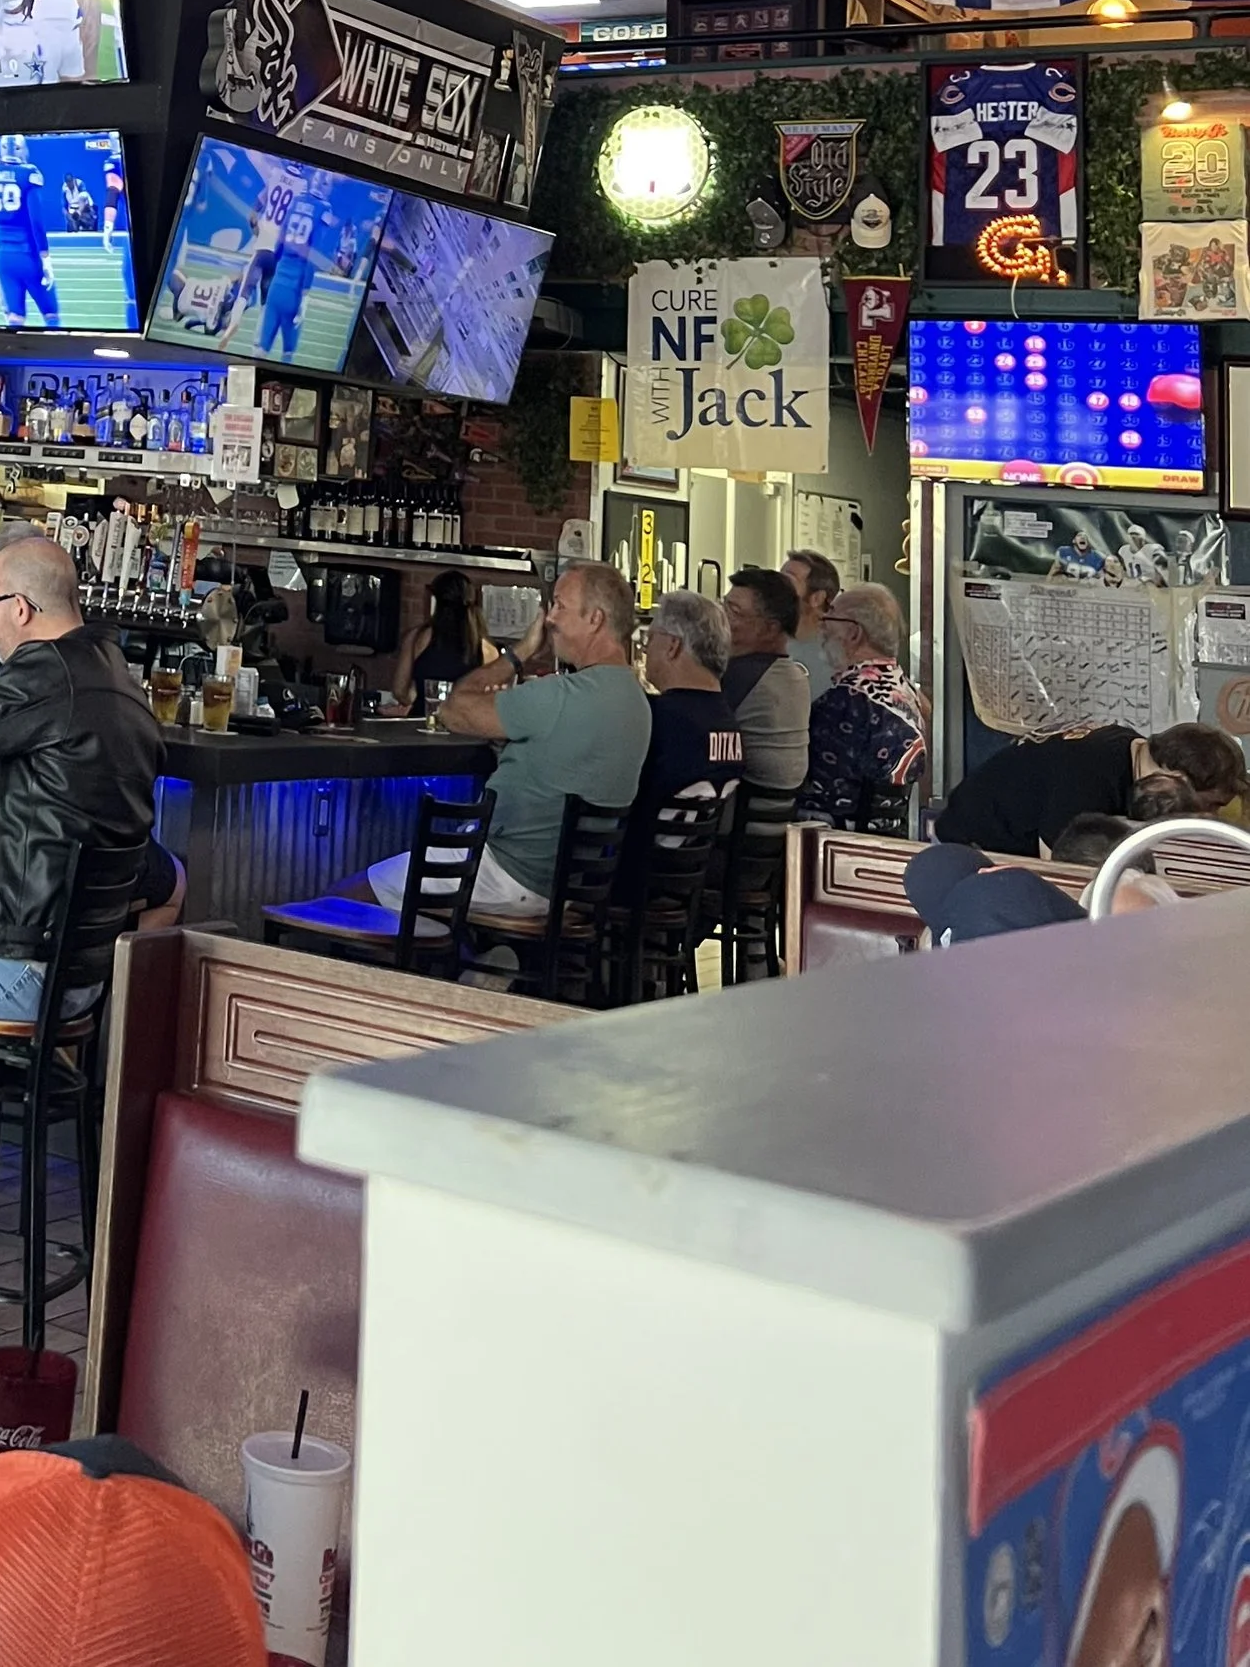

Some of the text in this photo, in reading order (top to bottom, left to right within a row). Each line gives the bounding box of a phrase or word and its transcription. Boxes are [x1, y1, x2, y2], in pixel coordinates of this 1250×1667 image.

[593, 22, 668, 43] COLD
[9, 59, 18, 72] 0
[338, 31, 421, 123] WHITE
[421, 64, 483, 141] SOX
[976, 101, 1039, 123] HESTER
[301, 122, 376, 155] FANS
[397, 150, 467, 184] ONLY
[811, 134, 848, 170] Old
[964, 139, 1040, 210] 23
[1161, 140, 1230, 188] 20
[267, 185, 294, 227] 98
[788, 162, 846, 208] Style
[652, 290, 718, 311] CURE
[652, 316, 718, 361] NF
[855, 341, 869, 394] CHICAGO
[864, 335, 882, 401] UNIVERSITY
[877, 345, 894, 392] LOYOLA
[651, 367, 670, 424] WITH
[666, 368, 812, 440] Jack
[1003, 472, 1200, 483] NONE DRAW
[641, 510, 654, 584] 312
[709, 731, 743, 762] DITKA
